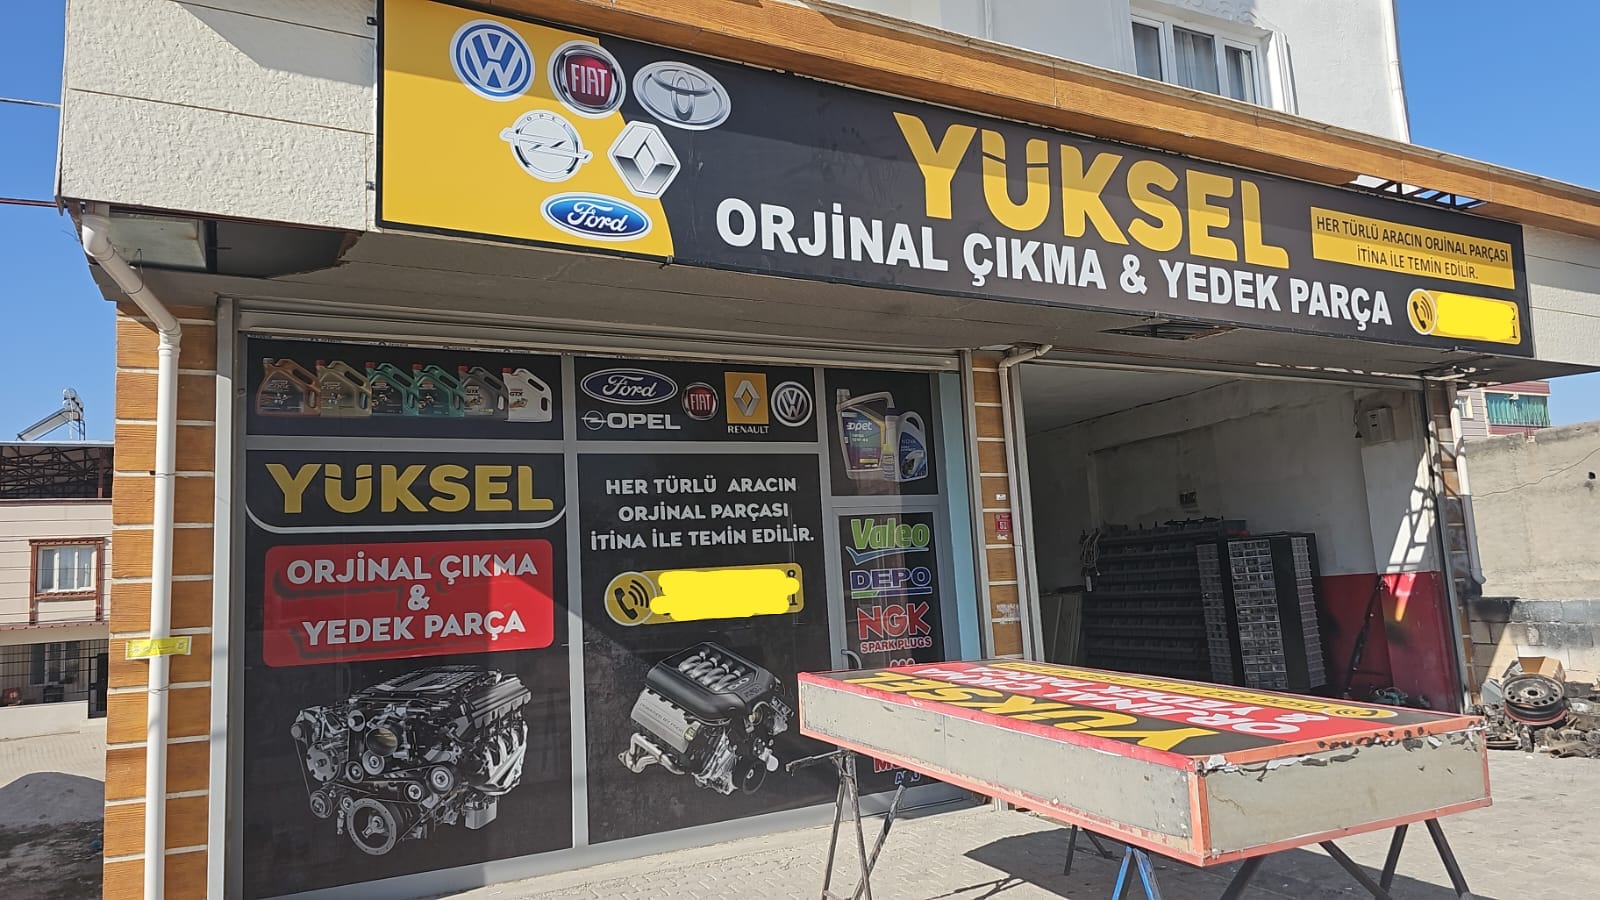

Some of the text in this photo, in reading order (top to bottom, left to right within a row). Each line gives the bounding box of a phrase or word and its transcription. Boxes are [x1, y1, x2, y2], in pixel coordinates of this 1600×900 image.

[570, 63, 608, 98] FIAT
[892, 111, 1290, 270] YÜKSEL
[567, 201, 628, 233] Ford
[1316, 215, 1509, 264] HER TÜRLÜ ARACIN ORJİNAL PARÇASI
[715, 197, 1393, 331] ORJİNAL ÇIKMA & YEDEK PARÇA
[1357, 245, 1479, 280] İTİNA İLE TEMİN EDİLİR.
[602, 374, 657, 398] Ford
[690, 393, 711, 411] FIAT
[607, 412, 682, 430] OPEL
[727, 425, 769, 434] RENAULT
[846, 421, 873, 431] opet
[264, 463, 555, 514] YÜKSEL
[605, 475, 797, 495] HER TÜRLÜ ARACIN
[618, 501, 789, 522] ORJİNAL PARÇASI
[591, 523, 815, 551] İTİNA İLE TEMİN EDİLİR.
[851, 517, 930, 550] Valeo
[286, 551, 538, 585] ORJİNAL ÇIKMA
[850, 566, 932, 590] DEPO
[407, 584, 430, 611] &
[302, 610, 527, 646] YEDEK PARÇA
[857, 601, 932, 640] NGK
[861, 636, 932, 654] SPARK PLUGS
[843, 671, 1220, 751] YÜKSEL
[1083, 685, 1264, 716] YEDEK
[1274, 713, 1330, 723] &
